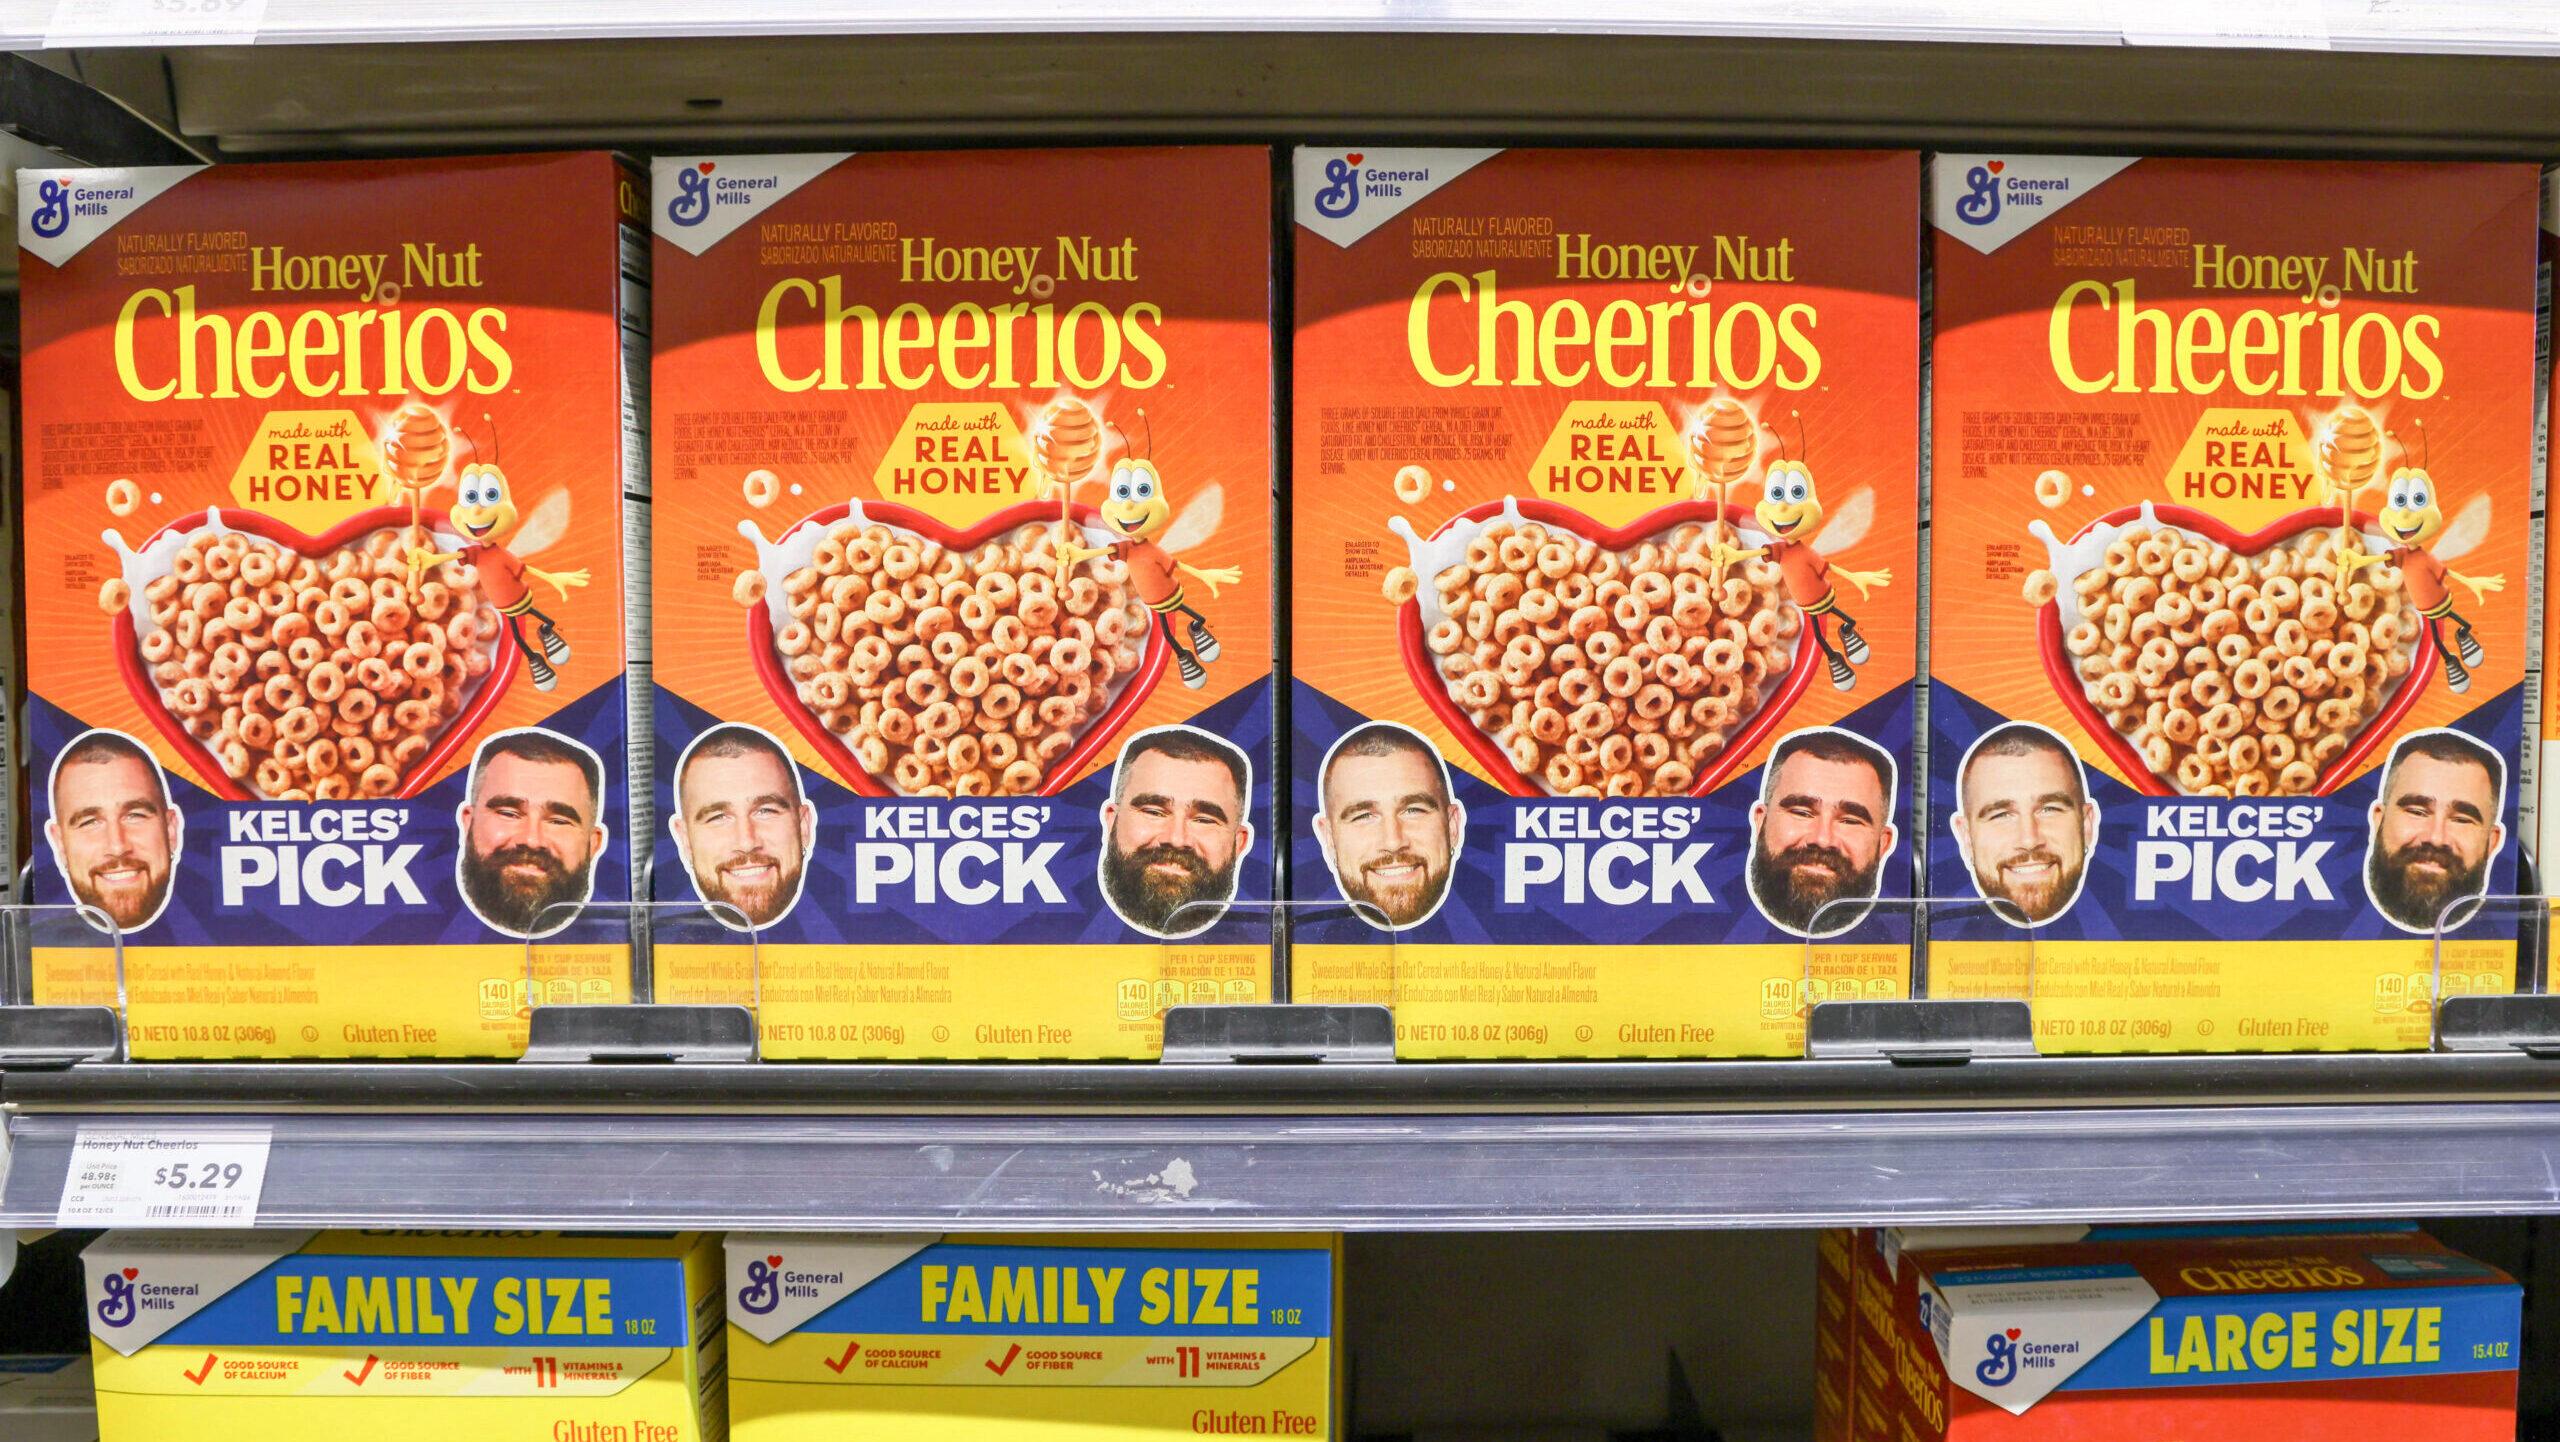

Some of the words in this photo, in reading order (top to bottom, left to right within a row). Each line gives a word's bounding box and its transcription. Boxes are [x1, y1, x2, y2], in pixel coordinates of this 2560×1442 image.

[717, 176, 777, 190] General
[1366, 168, 1429, 183] General
[2007, 177, 2069, 192] General
[75, 187, 133, 200] General
[717, 191, 750, 204] Mills
[1366, 184, 1402, 197] Mills
[2007, 193, 2042, 206] Mills
[75, 203, 108, 216] Mills
[762, 225, 831, 242] NATURALLY
[834, 223, 897, 242] FLAVORED
[1414, 218, 1485, 236] NATURALLY
[1488, 218, 1552, 236] FLAVORED
[762, 247, 819, 265] SABORIZADO
[823, 245, 897, 264] NATURALMENTE
[1413, 241, 1471, 258] SABORIZADO
[1475, 240, 1552, 258] NATURALMENTE
[251, 246, 387, 302] Honey
[402, 243, 483, 288] Nut
[901, 238, 1041, 294] Honey
[1057, 236, 1139, 281] Nut
[1556, 234, 1698, 293] Honey
[1714, 236, 1794, 281] Nut
[2193, 245, 2329, 302] Honey
[2343, 248, 2418, 294] Nut
[755, 276, 1167, 392] Cheerios
[1408, 270, 1821, 391] Cheerios
[2049, 279, 2444, 399] Cheerios
[114, 285, 513, 402] Cheerios
[269, 423, 312, 440] made
[316, 420, 351, 438] with
[916, 417, 956, 431] made
[960, 414, 999, 430] with
[1571, 416, 1613, 430] made
[1616, 412, 1656, 430] with
[2207, 423, 2247, 438] made
[2251, 420, 2288, 437] with
[916, 437, 1009, 462] REAL
[1571, 435, 1665, 461] REAL
[2206, 442, 2295, 468] REAL
[270, 444, 359, 471] REAL
[250, 474, 378, 500] HONEY
[894, 468, 1028, 494] HONEY
[1549, 467, 1684, 493] HONEY
[2185, 473, 2313, 499] HONEY
[229, 809, 409, 842] KELCES’
[866, 806, 1051, 839] KELCES’
[1515, 806, 1702, 840] KELCES’
[2147, 805, 2323, 838] KELCES’
[221, 843, 427, 907] PICK
[855, 841, 1067, 905] PICK
[1504, 841, 1715, 905] PICK
[2135, 839, 2335, 903] PICK
[1312, 962, 1354, 980] Sweetened
[1356, 962, 1379, 980] Whole
[1381, 962, 1401, 980] Gran
[1403, 962, 1416, 979] Oat
[1417, 962, 1442, 979] Cereal
[1443, 962, 1459, 979] with
[1461, 962, 1478, 979] Real
[1480, 962, 1503, 982] Honey
[1514, 962, 1542, 979] Natural
[1544, 962, 1571, 979] Almond
[1574, 962, 1596, 979] Flavor
[1121, 984, 1146, 1000] 140
[1765, 983, 1789, 999] 140
[144, 1026, 178, 1041] NETO
[183, 1026, 209, 1041] 10.8
[213, 1026, 230, 1041] OZ
[234, 1026, 276, 1044] (306g)
[344, 1024, 399, 1043] Gluten
[403, 1024, 437, 1042] Free
[769, 1026, 803, 1041] NETO
[809, 1026, 836, 1041] 10.8
[841, 1026, 858, 1041] OZ
[862, 1025, 905, 1044] (306g)
[975, 1025, 1032, 1043] Gluten
[1037, 1025, 1072, 1043] Free
[1411, 1026, 1446, 1041] NETO
[1452, 1026, 1479, 1041] 10.8
[1483, 1026, 1500, 1041] OZ
[1506, 1025, 1548, 1044] (306g)
[1619, 1024, 1675, 1042] Gluten
[1680, 1024, 1714, 1042] Free
[2040, 1020, 2074, 1035] NETO
[2080, 1020, 2105, 1035] 10.8
[2110, 1020, 2127, 1036] OZ
[2131, 1020, 2171, 1038] (306g)
[2238, 1018, 2292, 1036] Gluten
[2297, 1018, 2329, 1036] Free
[83, 1140, 120, 1152] Honey
[123, 1140, 144, 1149] Nut
[148, 1140, 198, 1150] Cheerios
[155, 1163, 243, 1189] $5.29
[785, 1272, 843, 1284] General
[2180, 1263, 2364, 1291] Cheerios
[141, 1284, 199, 1296] General
[785, 1286, 818, 1298] Mills
[922, 1265, 1126, 1324] FAMILY
[1140, 1267, 1258, 1325] SIZE
[141, 1298, 174, 1310] Mills
[276, 1276, 478, 1334] FAMILY
[493, 1277, 613, 1335] SIZE
[1271, 1309, 1283, 1324] 18
[1287, 1309, 1301, 1324] OZ
[625, 1320, 638, 1334] 18
[641, 1320, 656, 1334] OZ
[2023, 1341, 2079, 1354] General
[2150, 1311, 2316, 1374] LARGE
[2331, 1307, 2441, 1367] SIZE
[865, 1350, 896, 1359] GOOD
[898, 1350, 941, 1359] SOURCE
[1027, 1351, 1058, 1360] GOOD
[1060, 1351, 1102, 1360] SOURCE
[1206, 1352, 1258, 1360] VITAMINS
[1259, 1352, 1266, 1360] &
[2473, 1344, 2493, 1359] 15.4
[2496, 1342, 2509, 1358] OZ
[224, 1361, 255, 1370] GOOD
[257, 1361, 299, 1370] SOURCE
[384, 1361, 415, 1370] GOOD
[418, 1362, 459, 1370] SOURCE
[563, 1363, 614, 1371] VITAMINS
[617, 1363, 623, 1371] &
[865, 1360, 879, 1368] OF
[881, 1360, 928, 1369] CALCIUM
[1027, 1361, 1040, 1370] OF
[1043, 1361, 1073, 1370] FIBER
[1146, 1356, 1174, 1365] WITH
[1176, 1347, 1199, 1378] 11
[1206, 1362, 1259, 1370] MINERALS
[2023, 1356, 2055, 1368] Mills
[224, 1372, 239, 1380] OF
[241, 1371, 287, 1380] CALCIUM
[385, 1372, 399, 1380] OF
[401, 1372, 431, 1380] FIBER
[503, 1367, 532, 1375] WITH
[533, 1357, 557, 1388] 11
[563, 1372, 618, 1380] MINERALS
[554, 1420, 627, 1442] Gluten
[634, 1420, 678, 1442] Free
[1193, 1410, 1266, 1434] Gluten
[1273, 1410, 1316, 1434] Free
